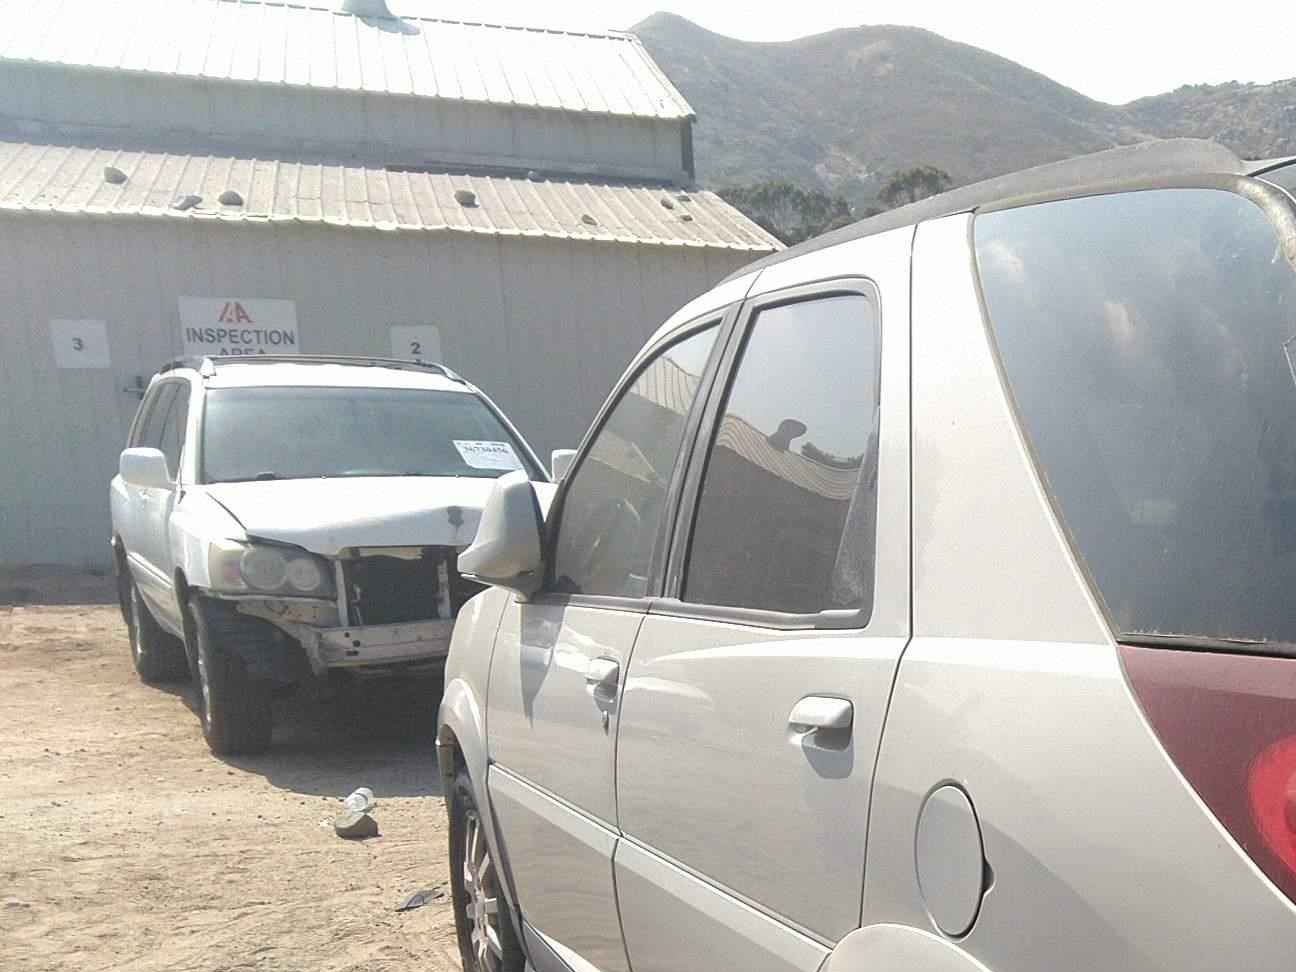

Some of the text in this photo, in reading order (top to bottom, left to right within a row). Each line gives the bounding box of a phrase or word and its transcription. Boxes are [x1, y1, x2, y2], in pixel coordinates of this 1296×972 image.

[185, 327, 295, 345] INSPECTION
[71, 337, 84, 351] 3
[410, 341, 422, 354] 2
